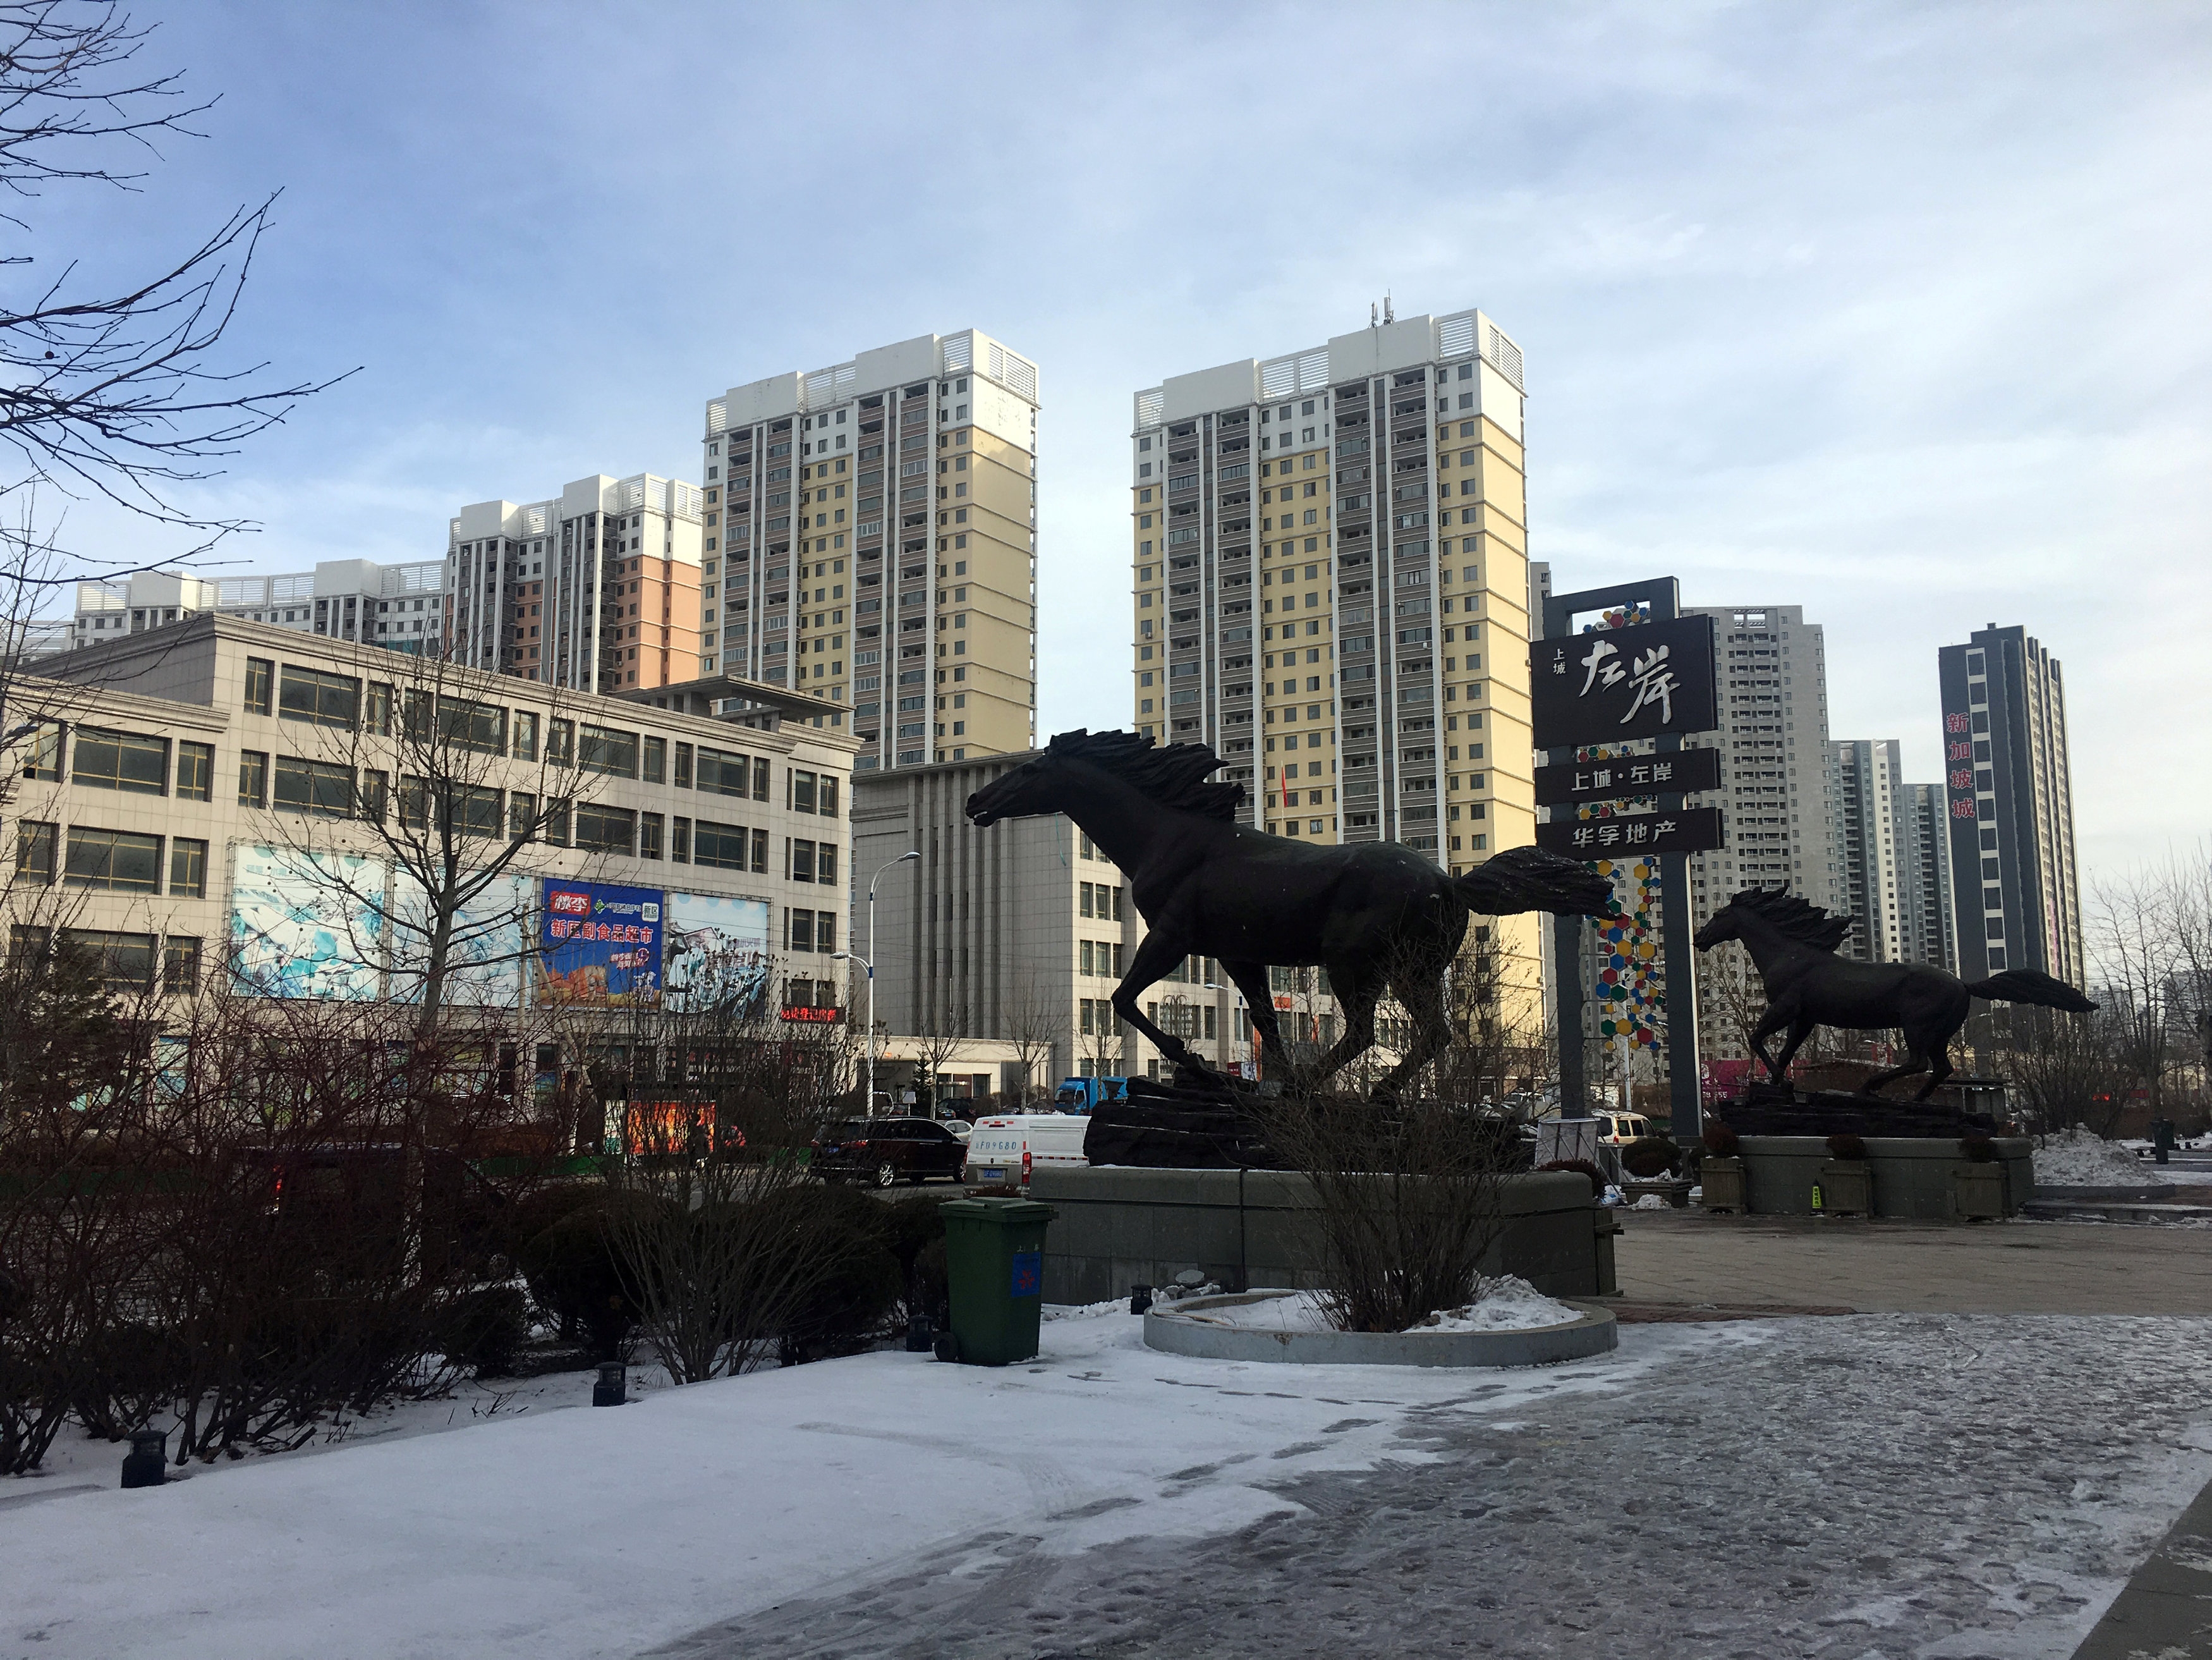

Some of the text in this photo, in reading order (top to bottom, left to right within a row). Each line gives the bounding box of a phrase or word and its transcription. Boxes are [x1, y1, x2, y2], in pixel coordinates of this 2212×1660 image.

[1553, 648, 1566, 674] 上城
[1579, 640, 1680, 724] 左岸
[1947, 712, 1976, 819] 新加坡城
[1572, 820, 1676, 848] 华孚地产
